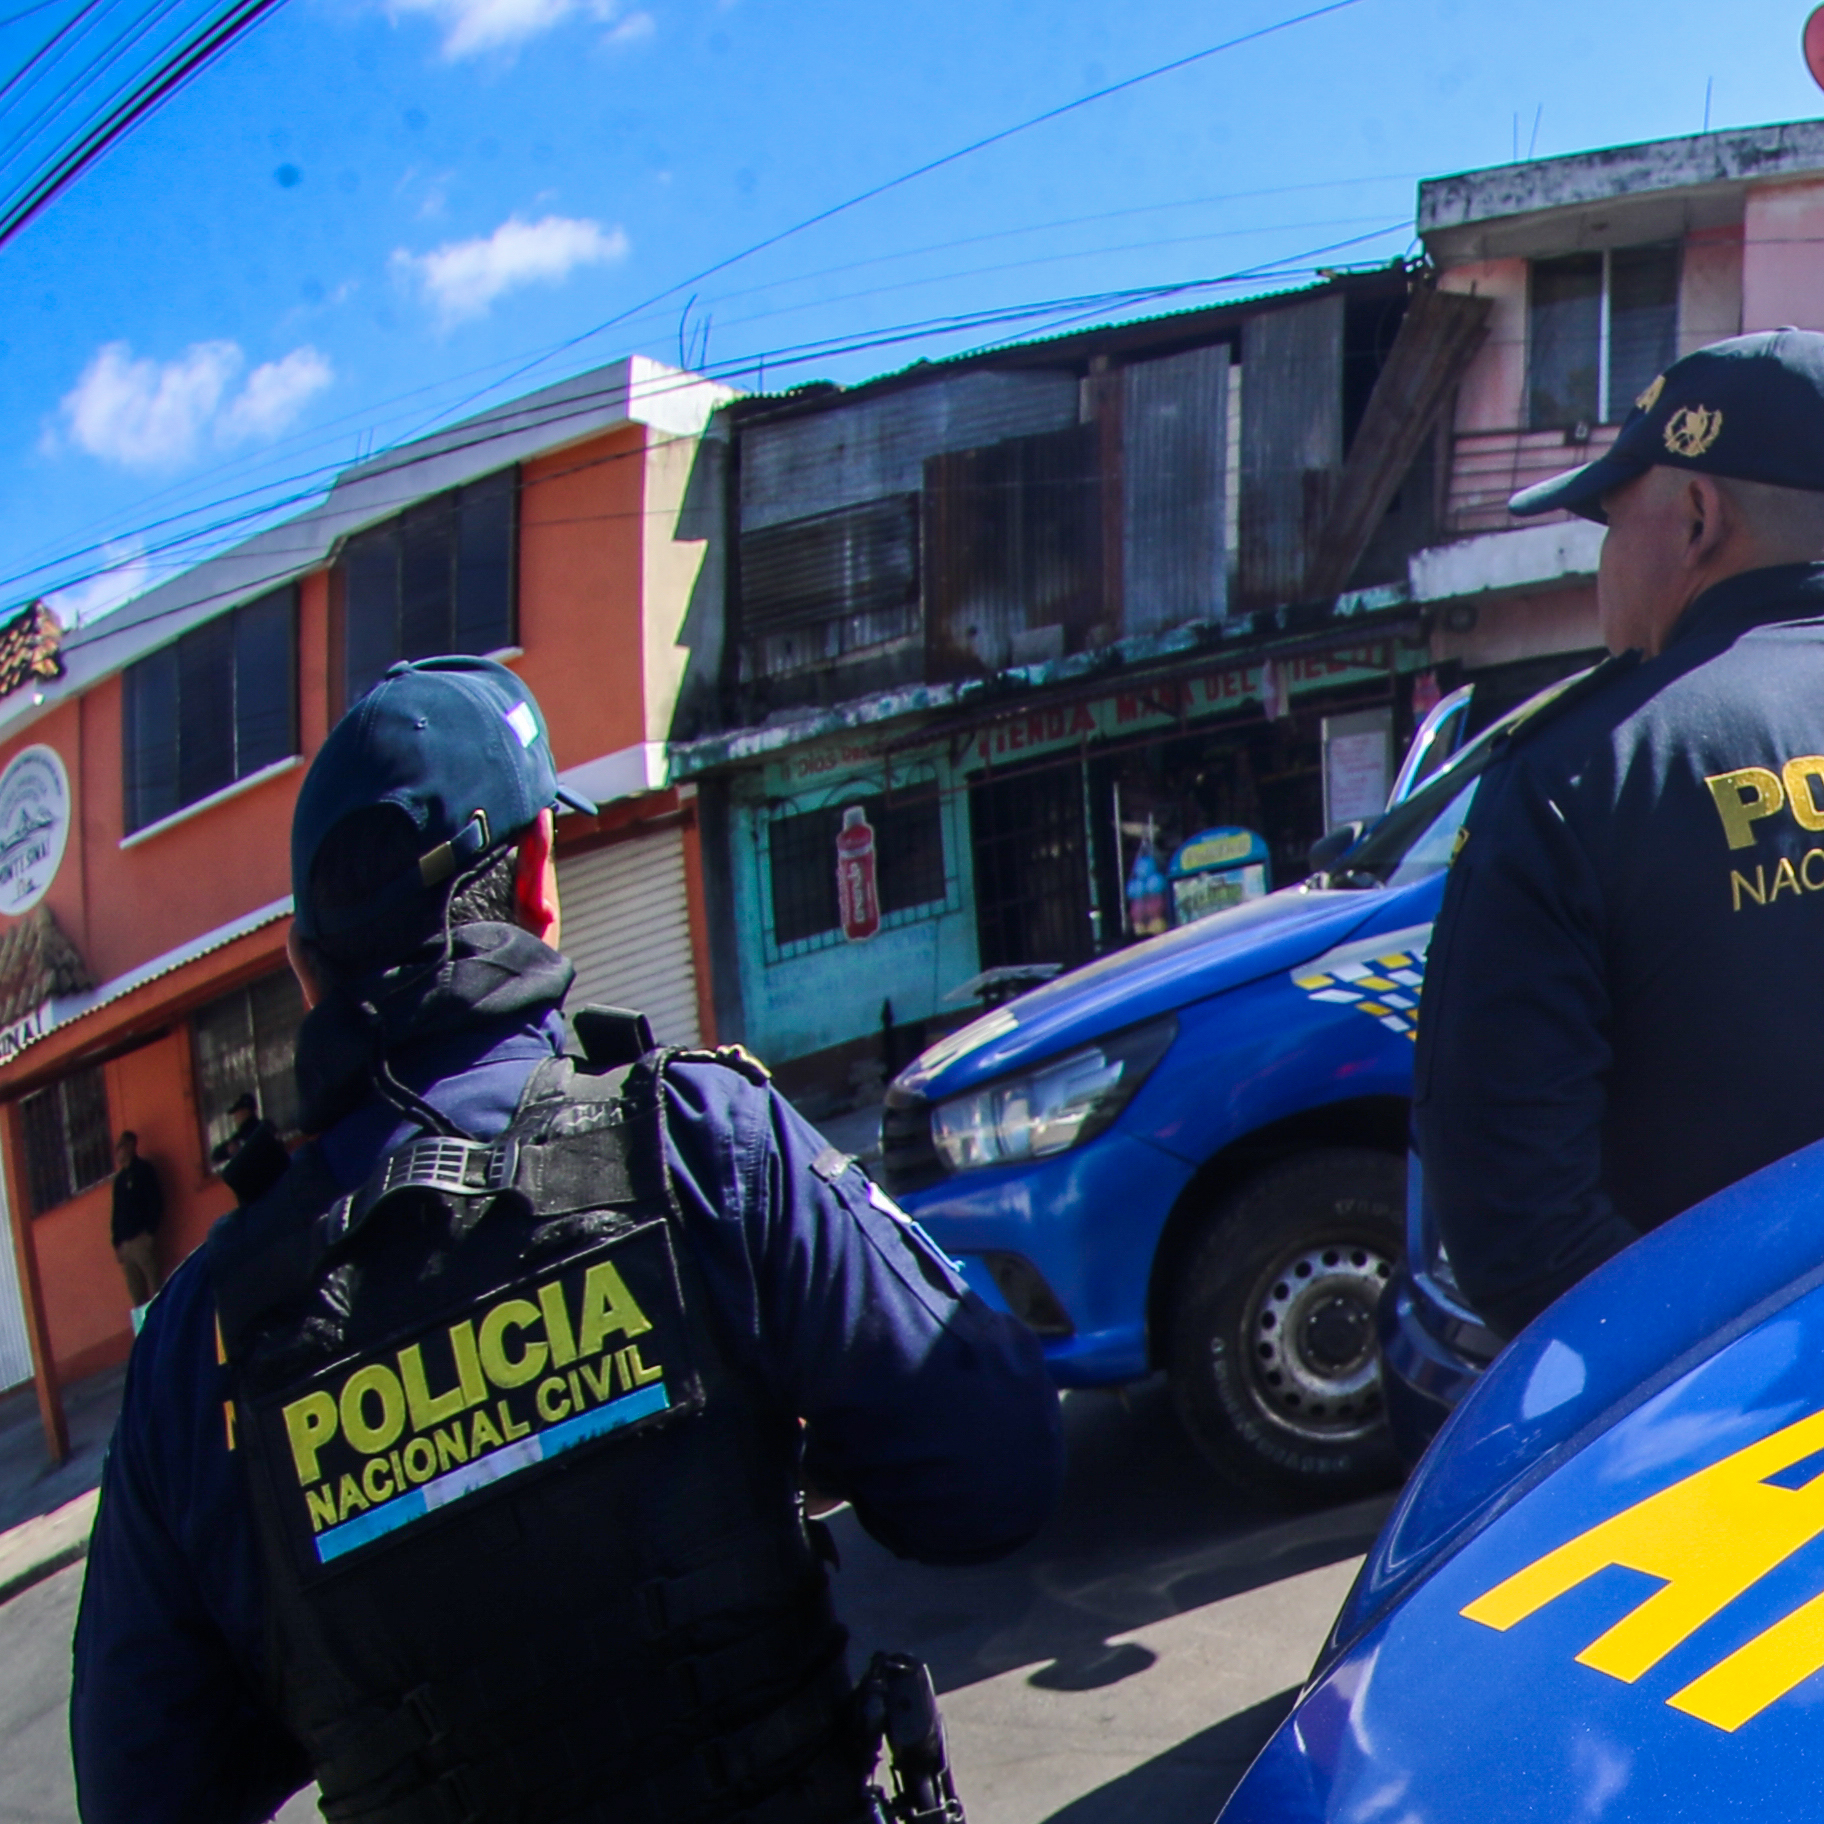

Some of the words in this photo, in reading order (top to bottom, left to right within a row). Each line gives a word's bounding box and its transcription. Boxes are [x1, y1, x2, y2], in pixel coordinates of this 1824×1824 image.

[282, 1260, 653, 1487] POLICIA
[305, 1399, 531, 1532] NACIONAL
[536, 1344, 663, 1422] CIVIL
